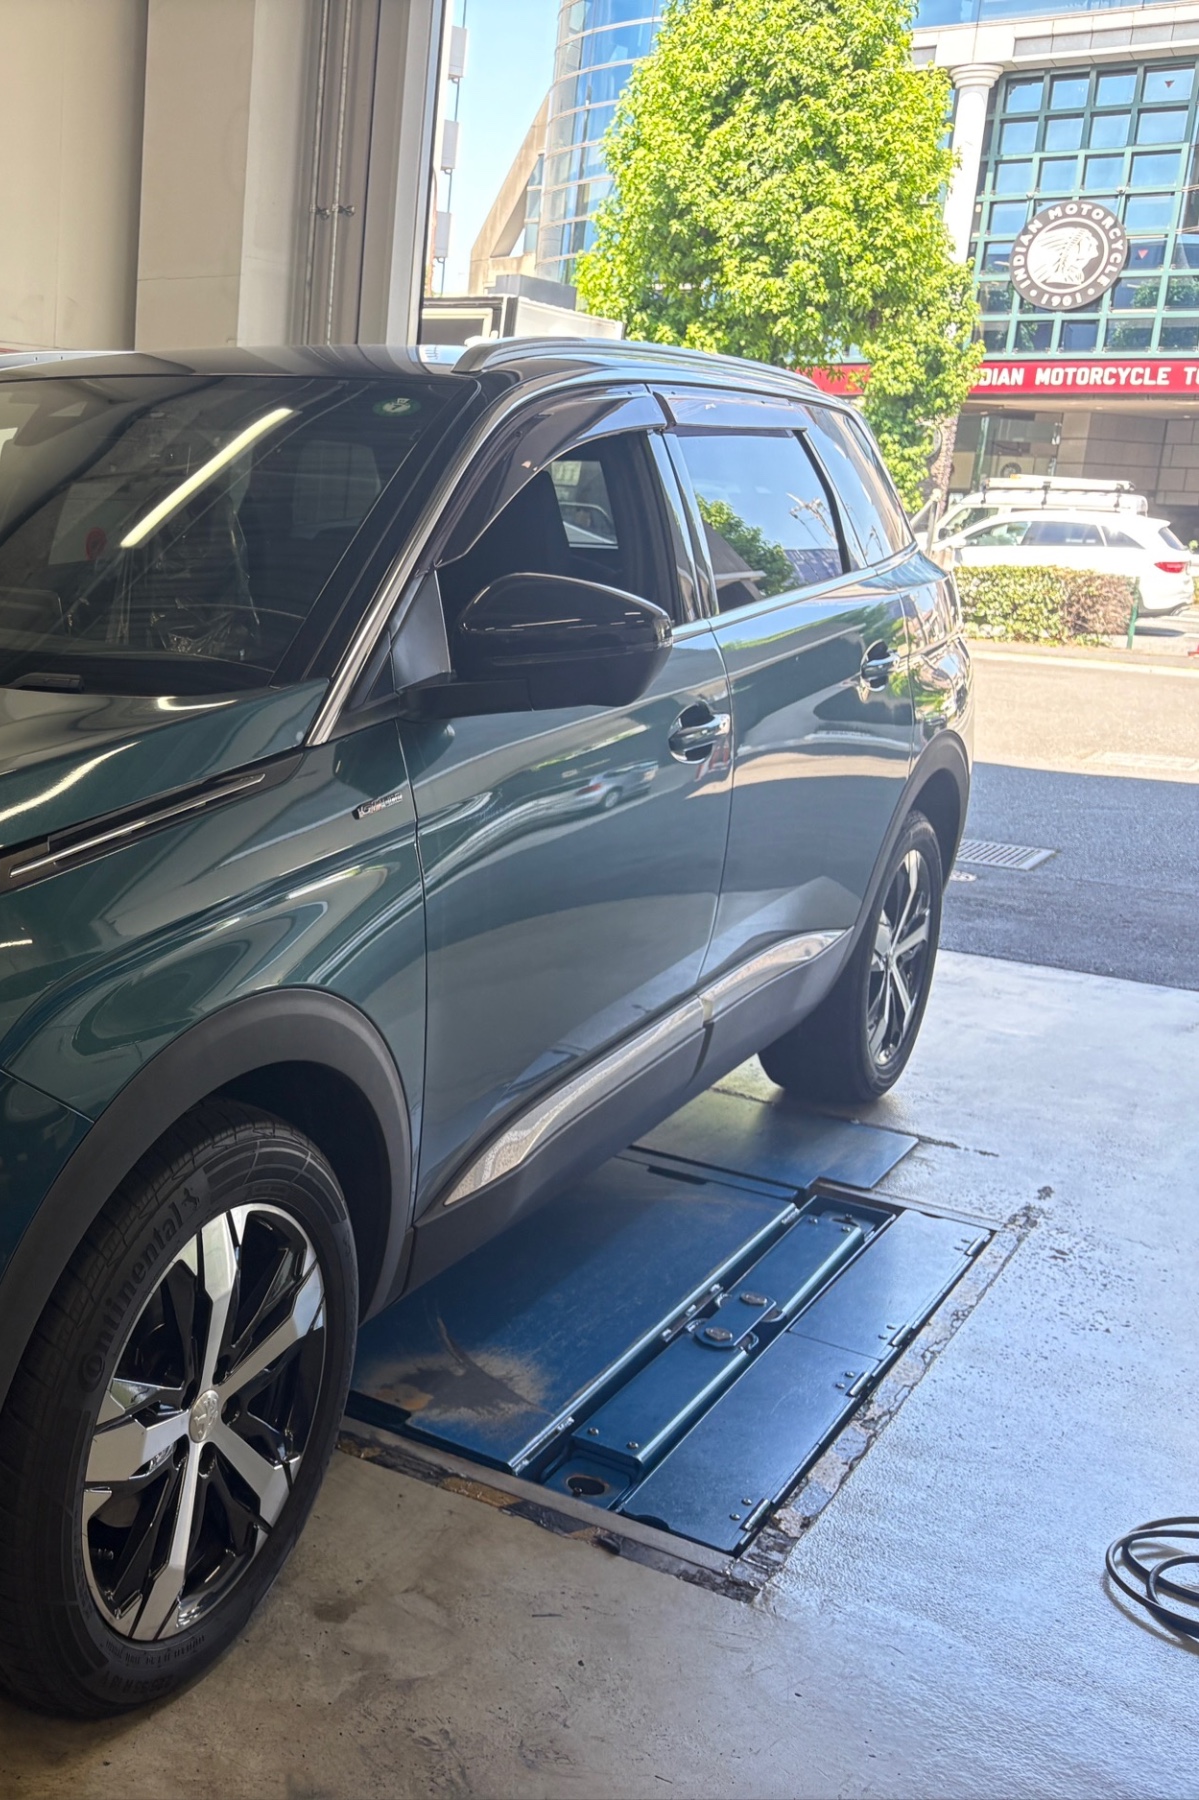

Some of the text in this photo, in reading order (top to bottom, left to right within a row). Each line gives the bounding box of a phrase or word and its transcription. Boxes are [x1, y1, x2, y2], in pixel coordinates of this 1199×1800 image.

[1013, 203, 1123, 289] INDIAN MOTORCYCLE
[1041, 292, 1082, 307] 1901
[975, 367, 1199, 386] DIAN MOTORCYCLE T
[81, 1201, 184, 1393] Continental
